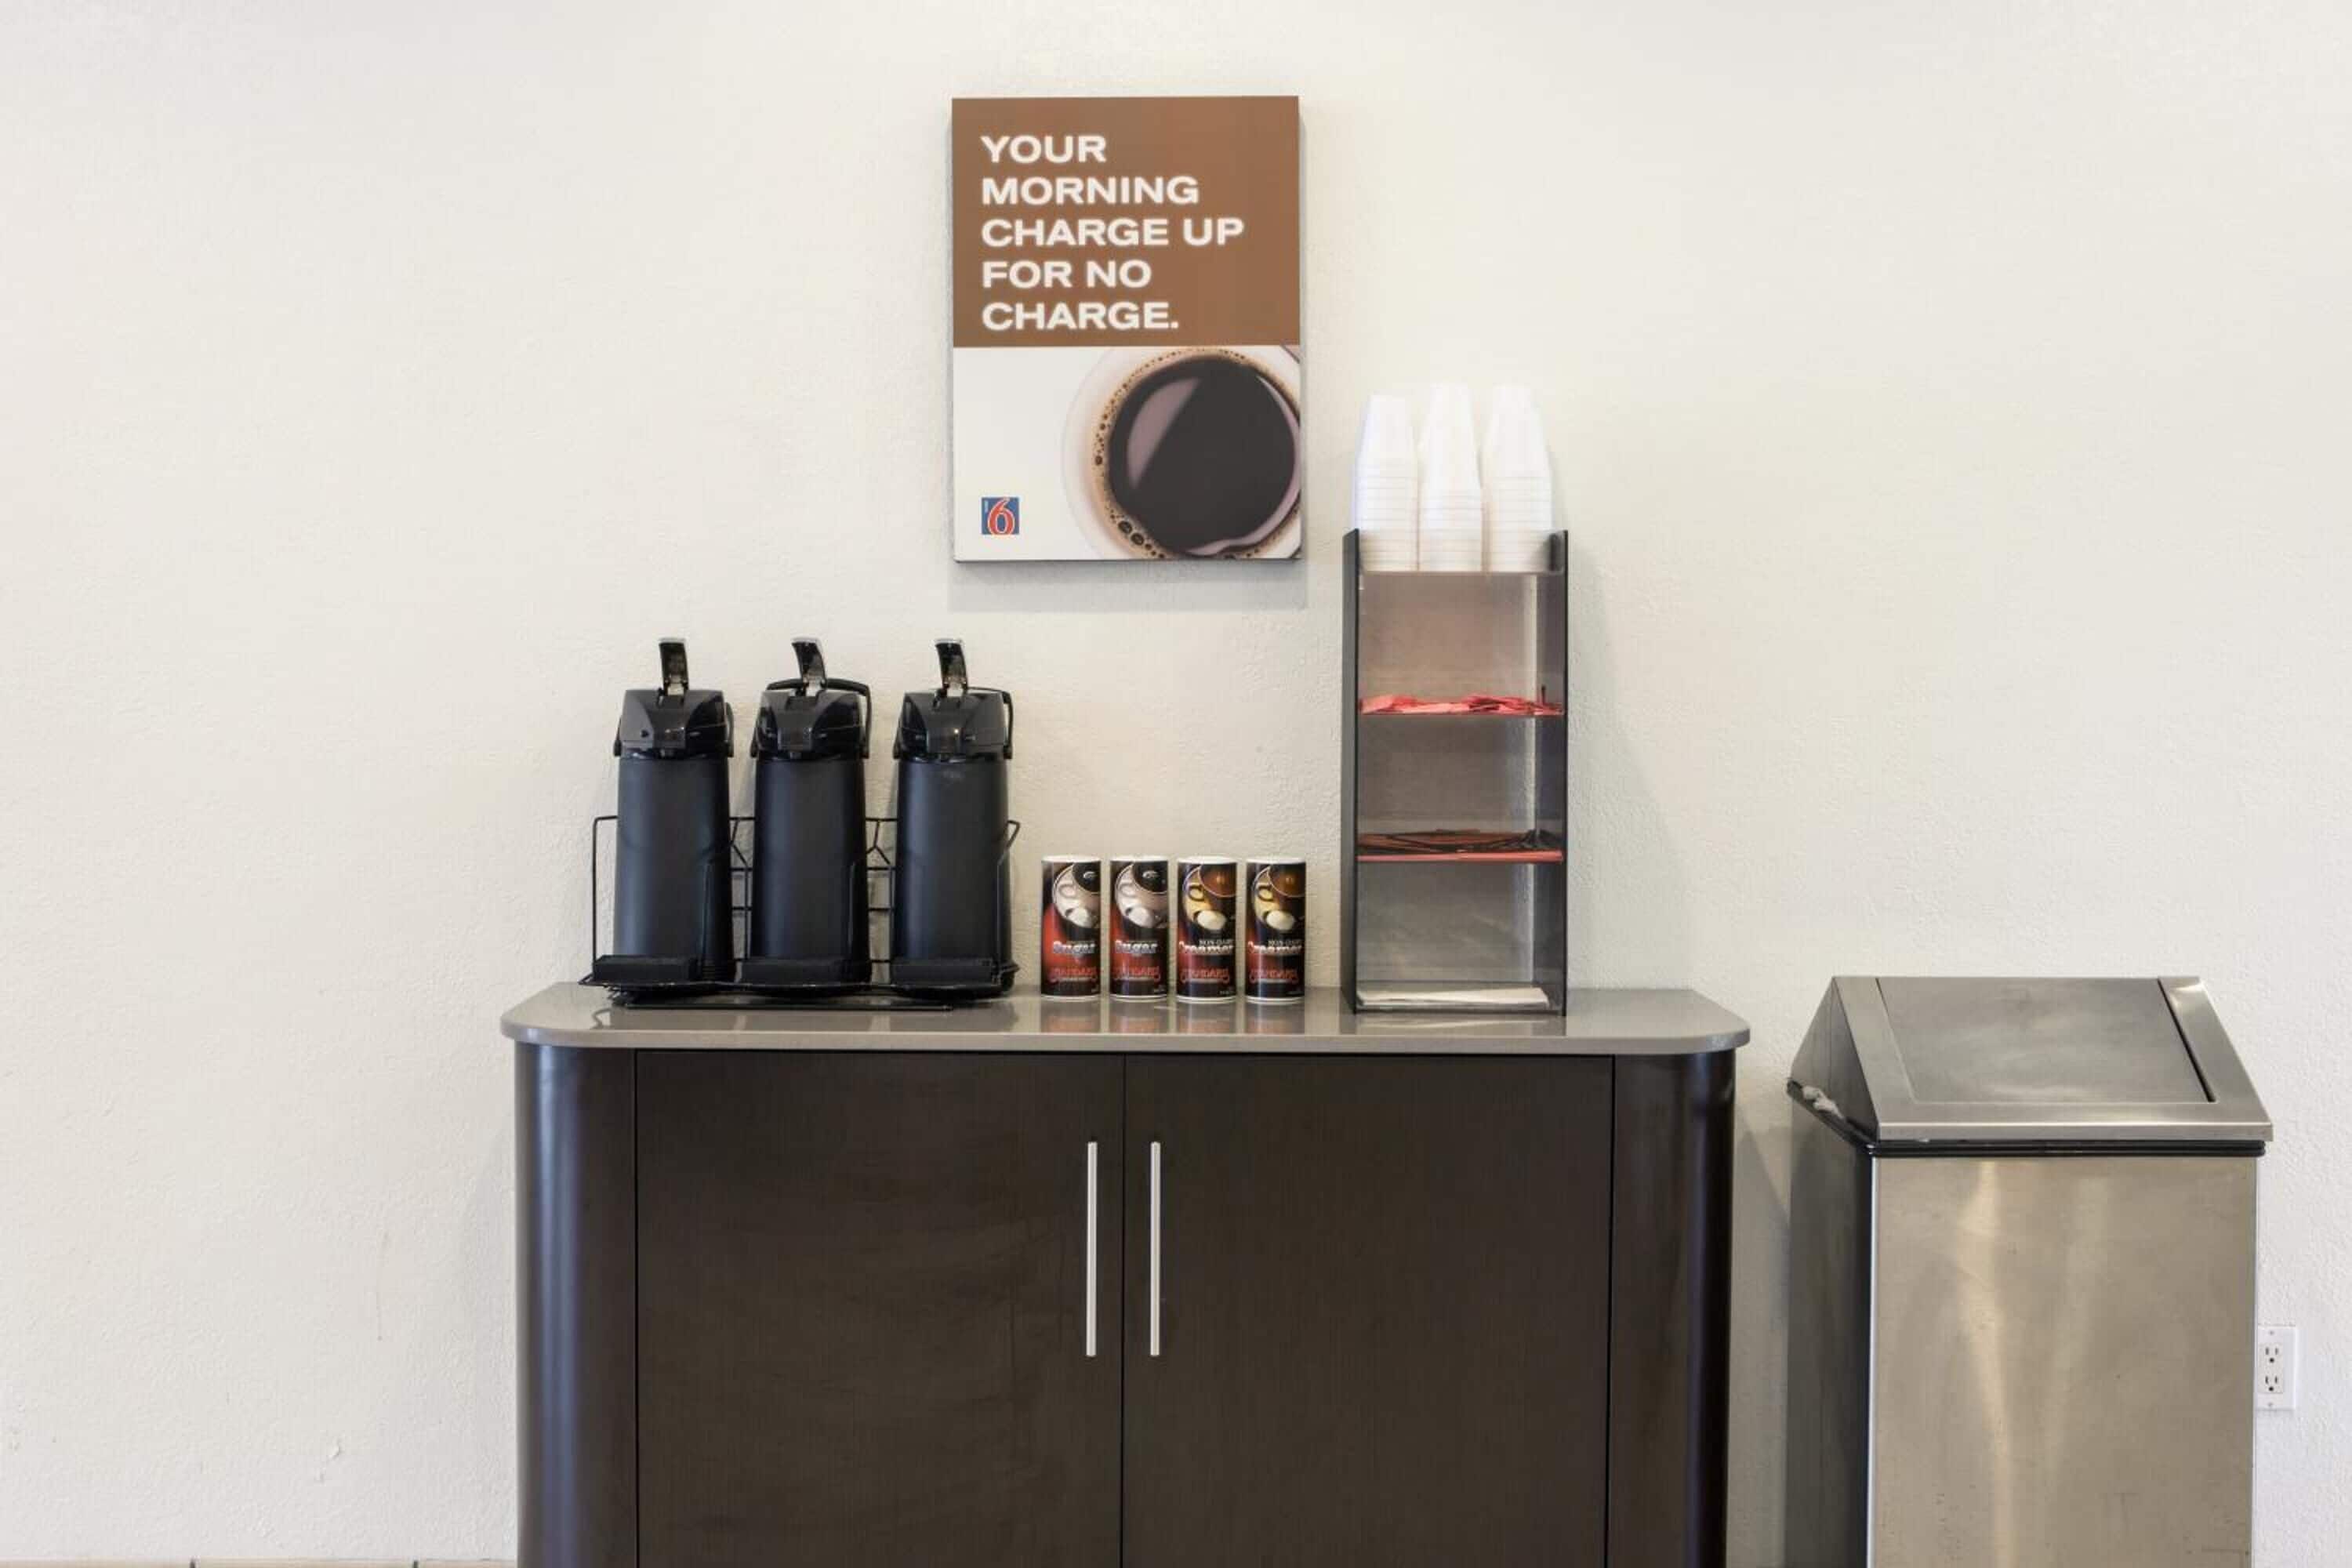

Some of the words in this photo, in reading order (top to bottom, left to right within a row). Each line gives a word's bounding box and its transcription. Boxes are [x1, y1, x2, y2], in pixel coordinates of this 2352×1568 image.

[981, 135, 1106, 163] YOUR
[982, 176, 1199, 205] MORNING
[982, 217, 1169, 247] CHARGE
[1182, 217, 1244, 247] UP
[982, 260, 1073, 289] FOR
[1086, 260, 1152, 289] NO
[982, 301, 1178, 331] CHARGE.
[987, 495, 1015, 535] 6
